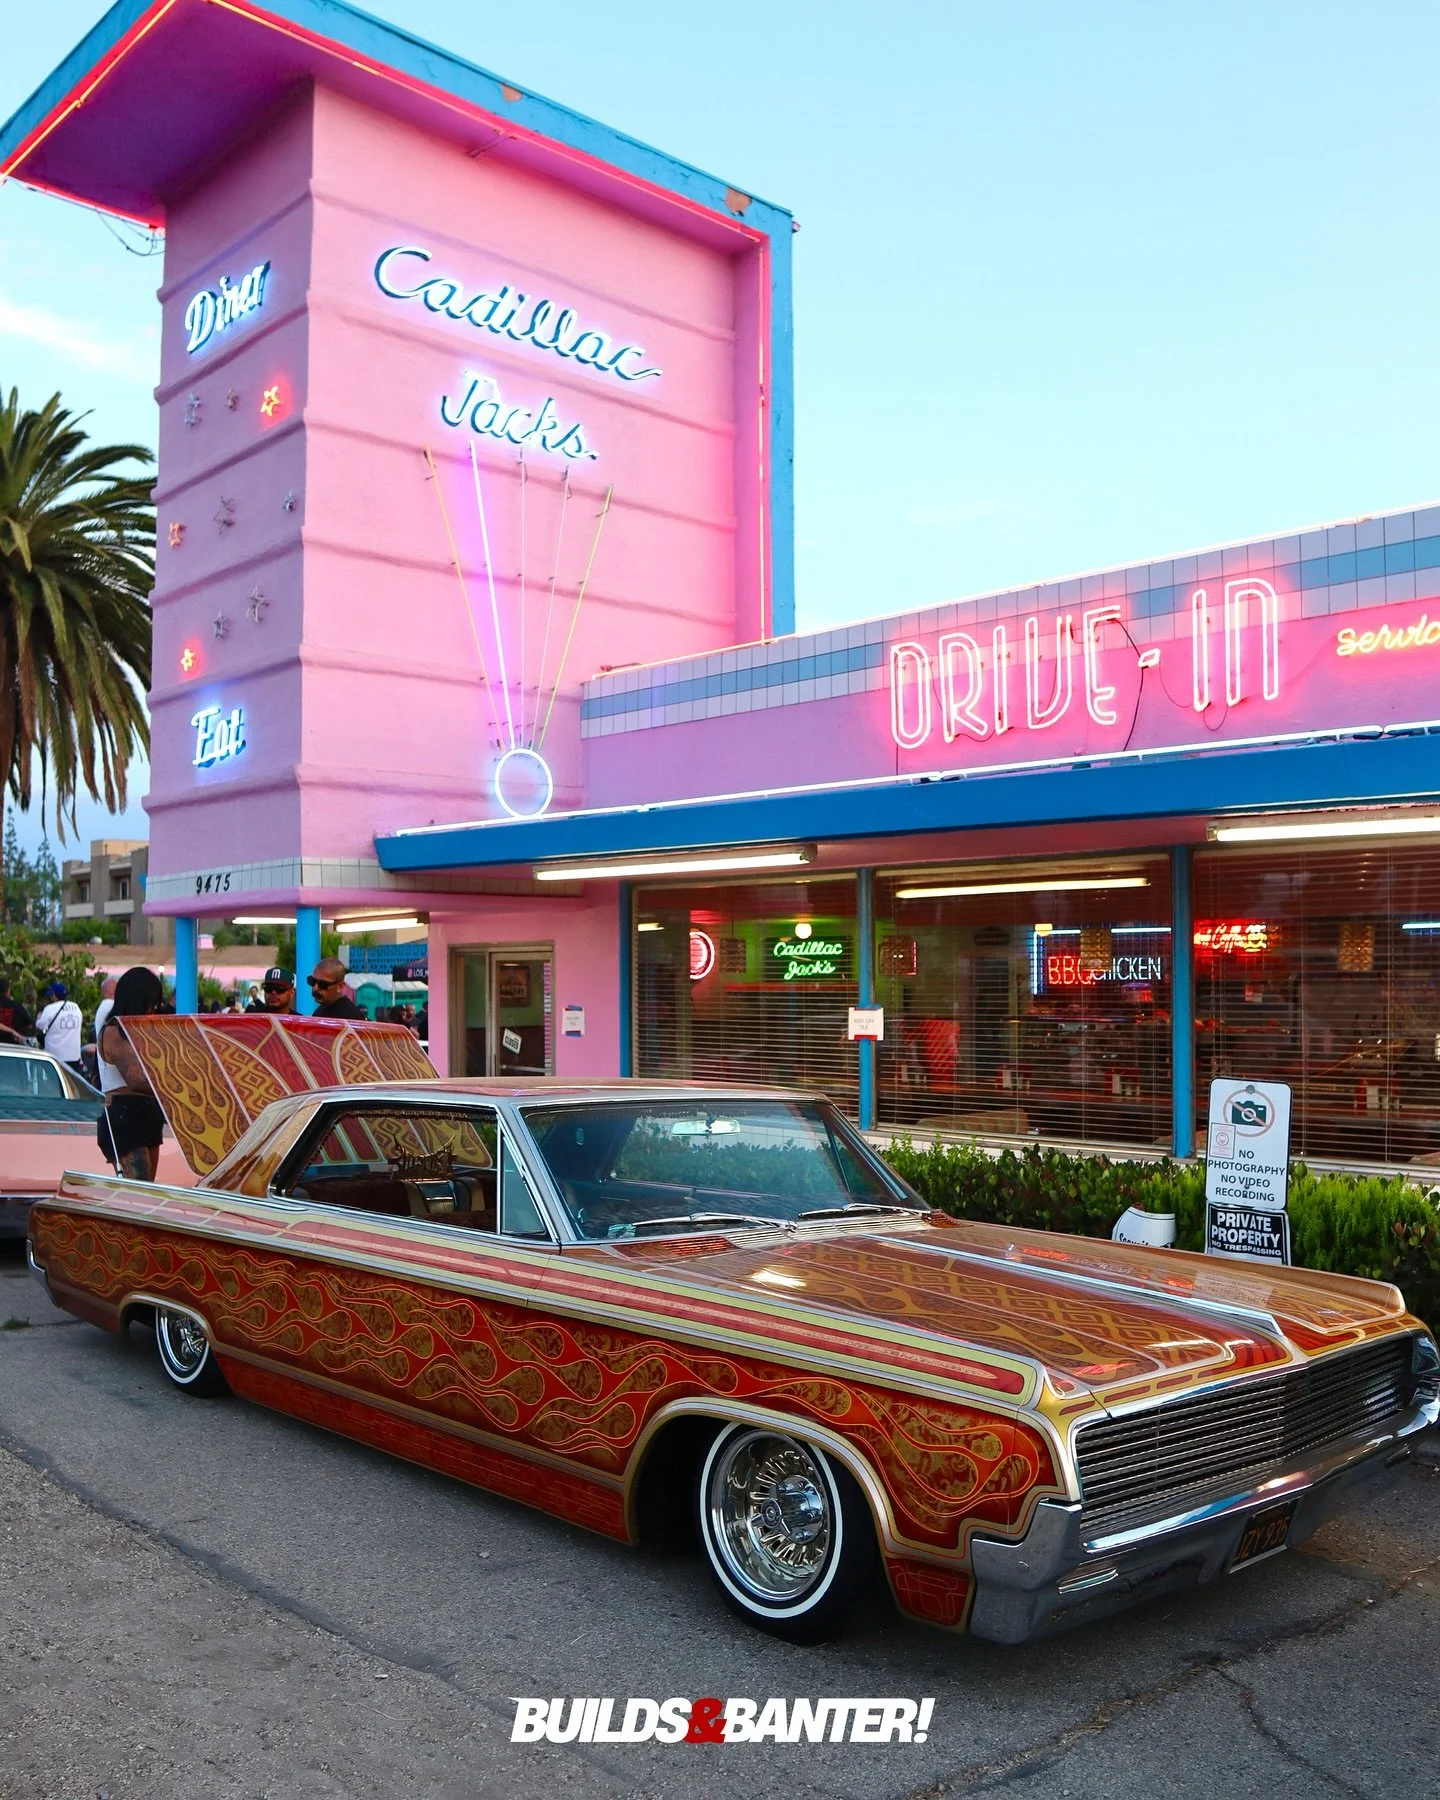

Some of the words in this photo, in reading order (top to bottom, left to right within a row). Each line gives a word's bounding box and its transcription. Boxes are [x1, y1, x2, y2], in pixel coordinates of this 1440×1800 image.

[185, 260, 271, 354] Diner
[374, 246, 663, 381] Cadillac
[191, 707, 246, 768] Eat
[196, 872, 231, 895] 9475
[773, 941, 843, 957] Cadillac
[784, 960, 836, 980] Jack's
[1239, 1150, 1254, 1159] NO
[1208, 1160, 1285, 1175] PHOTOGRAPHY
[1221, 1175, 1236, 1184] NO
[1239, 1177, 1270, 1188] VIDEO
[1216, 1187, 1275, 1202] RECORDING
[1217, 1212, 1272, 1232] PRIVATE
[1212, 1225, 1280, 1248] PROPERTY
[1212, 1240, 1221, 1248] NO
[1224, 1243, 1281, 1256] TRESPASSING
